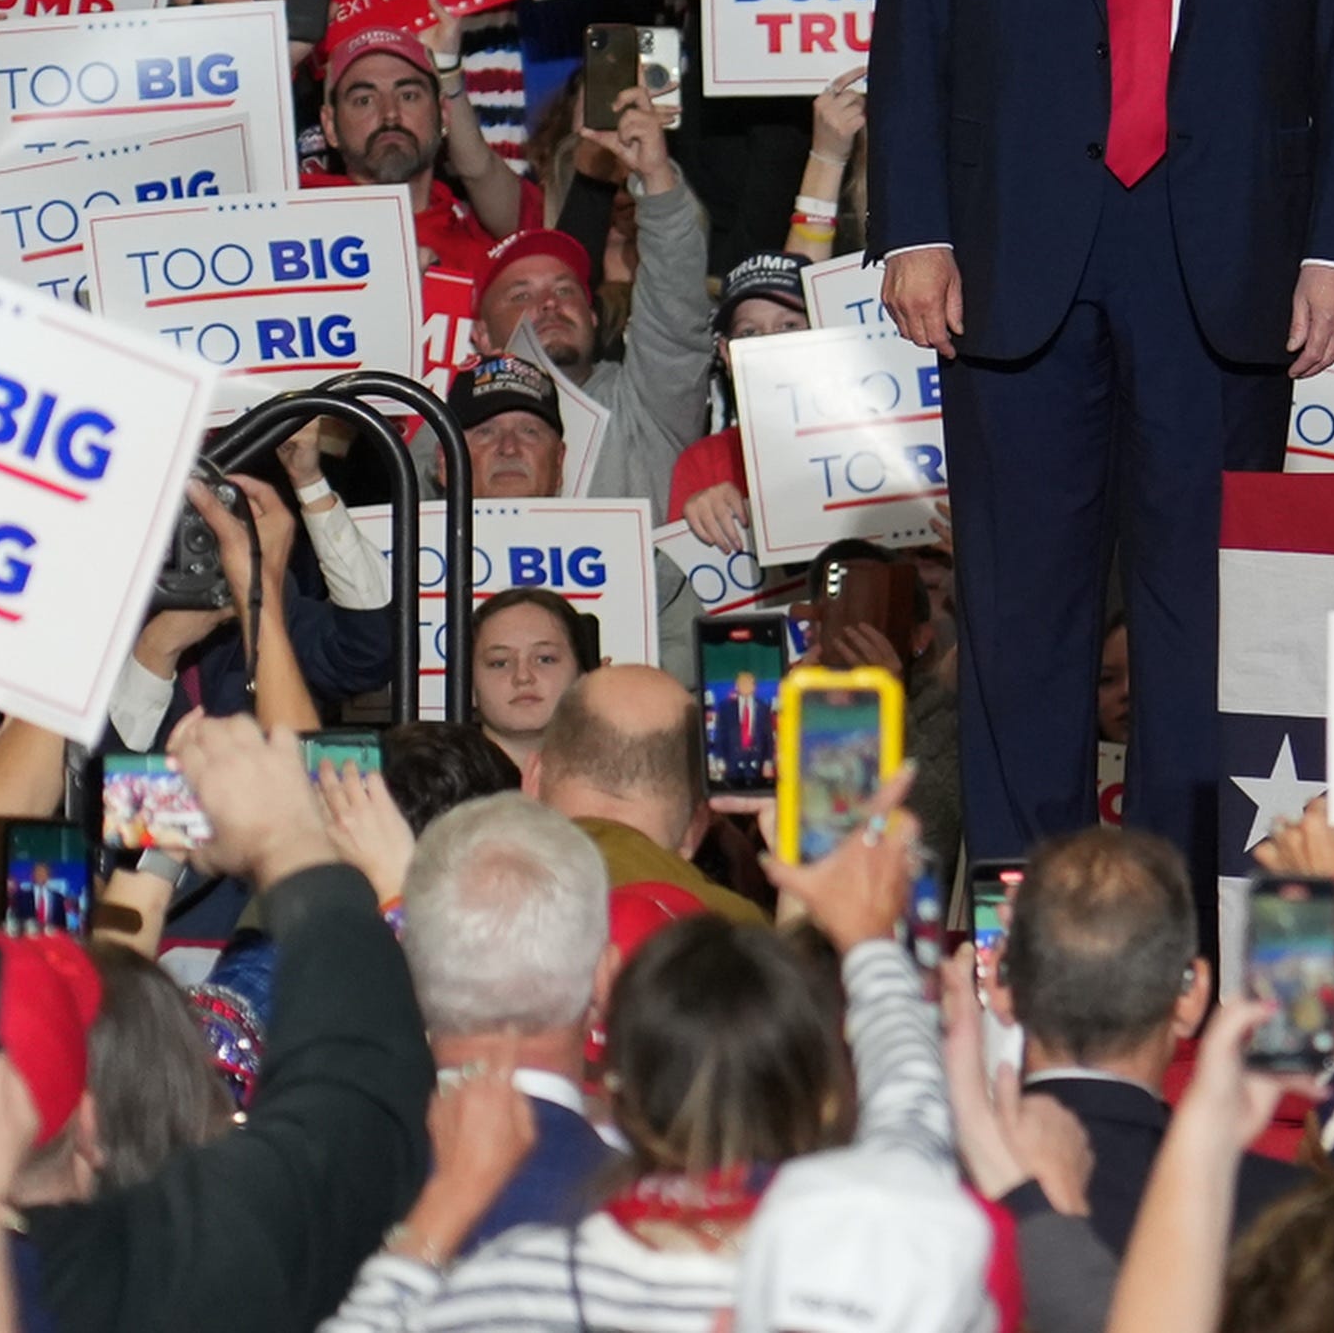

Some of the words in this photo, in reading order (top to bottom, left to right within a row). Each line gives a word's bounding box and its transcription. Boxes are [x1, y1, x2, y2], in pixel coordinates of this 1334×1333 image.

[135, 54, 239, 100] BIG
[127, 242, 254, 294] TOO
[268, 235, 370, 282] BIG
[726, 255, 799, 285] TRUMP
[160, 322, 240, 364] TO
[257, 315, 357, 360] RIG
[810, 451, 886, 498] TO
[507, 546, 607, 588] BIG
